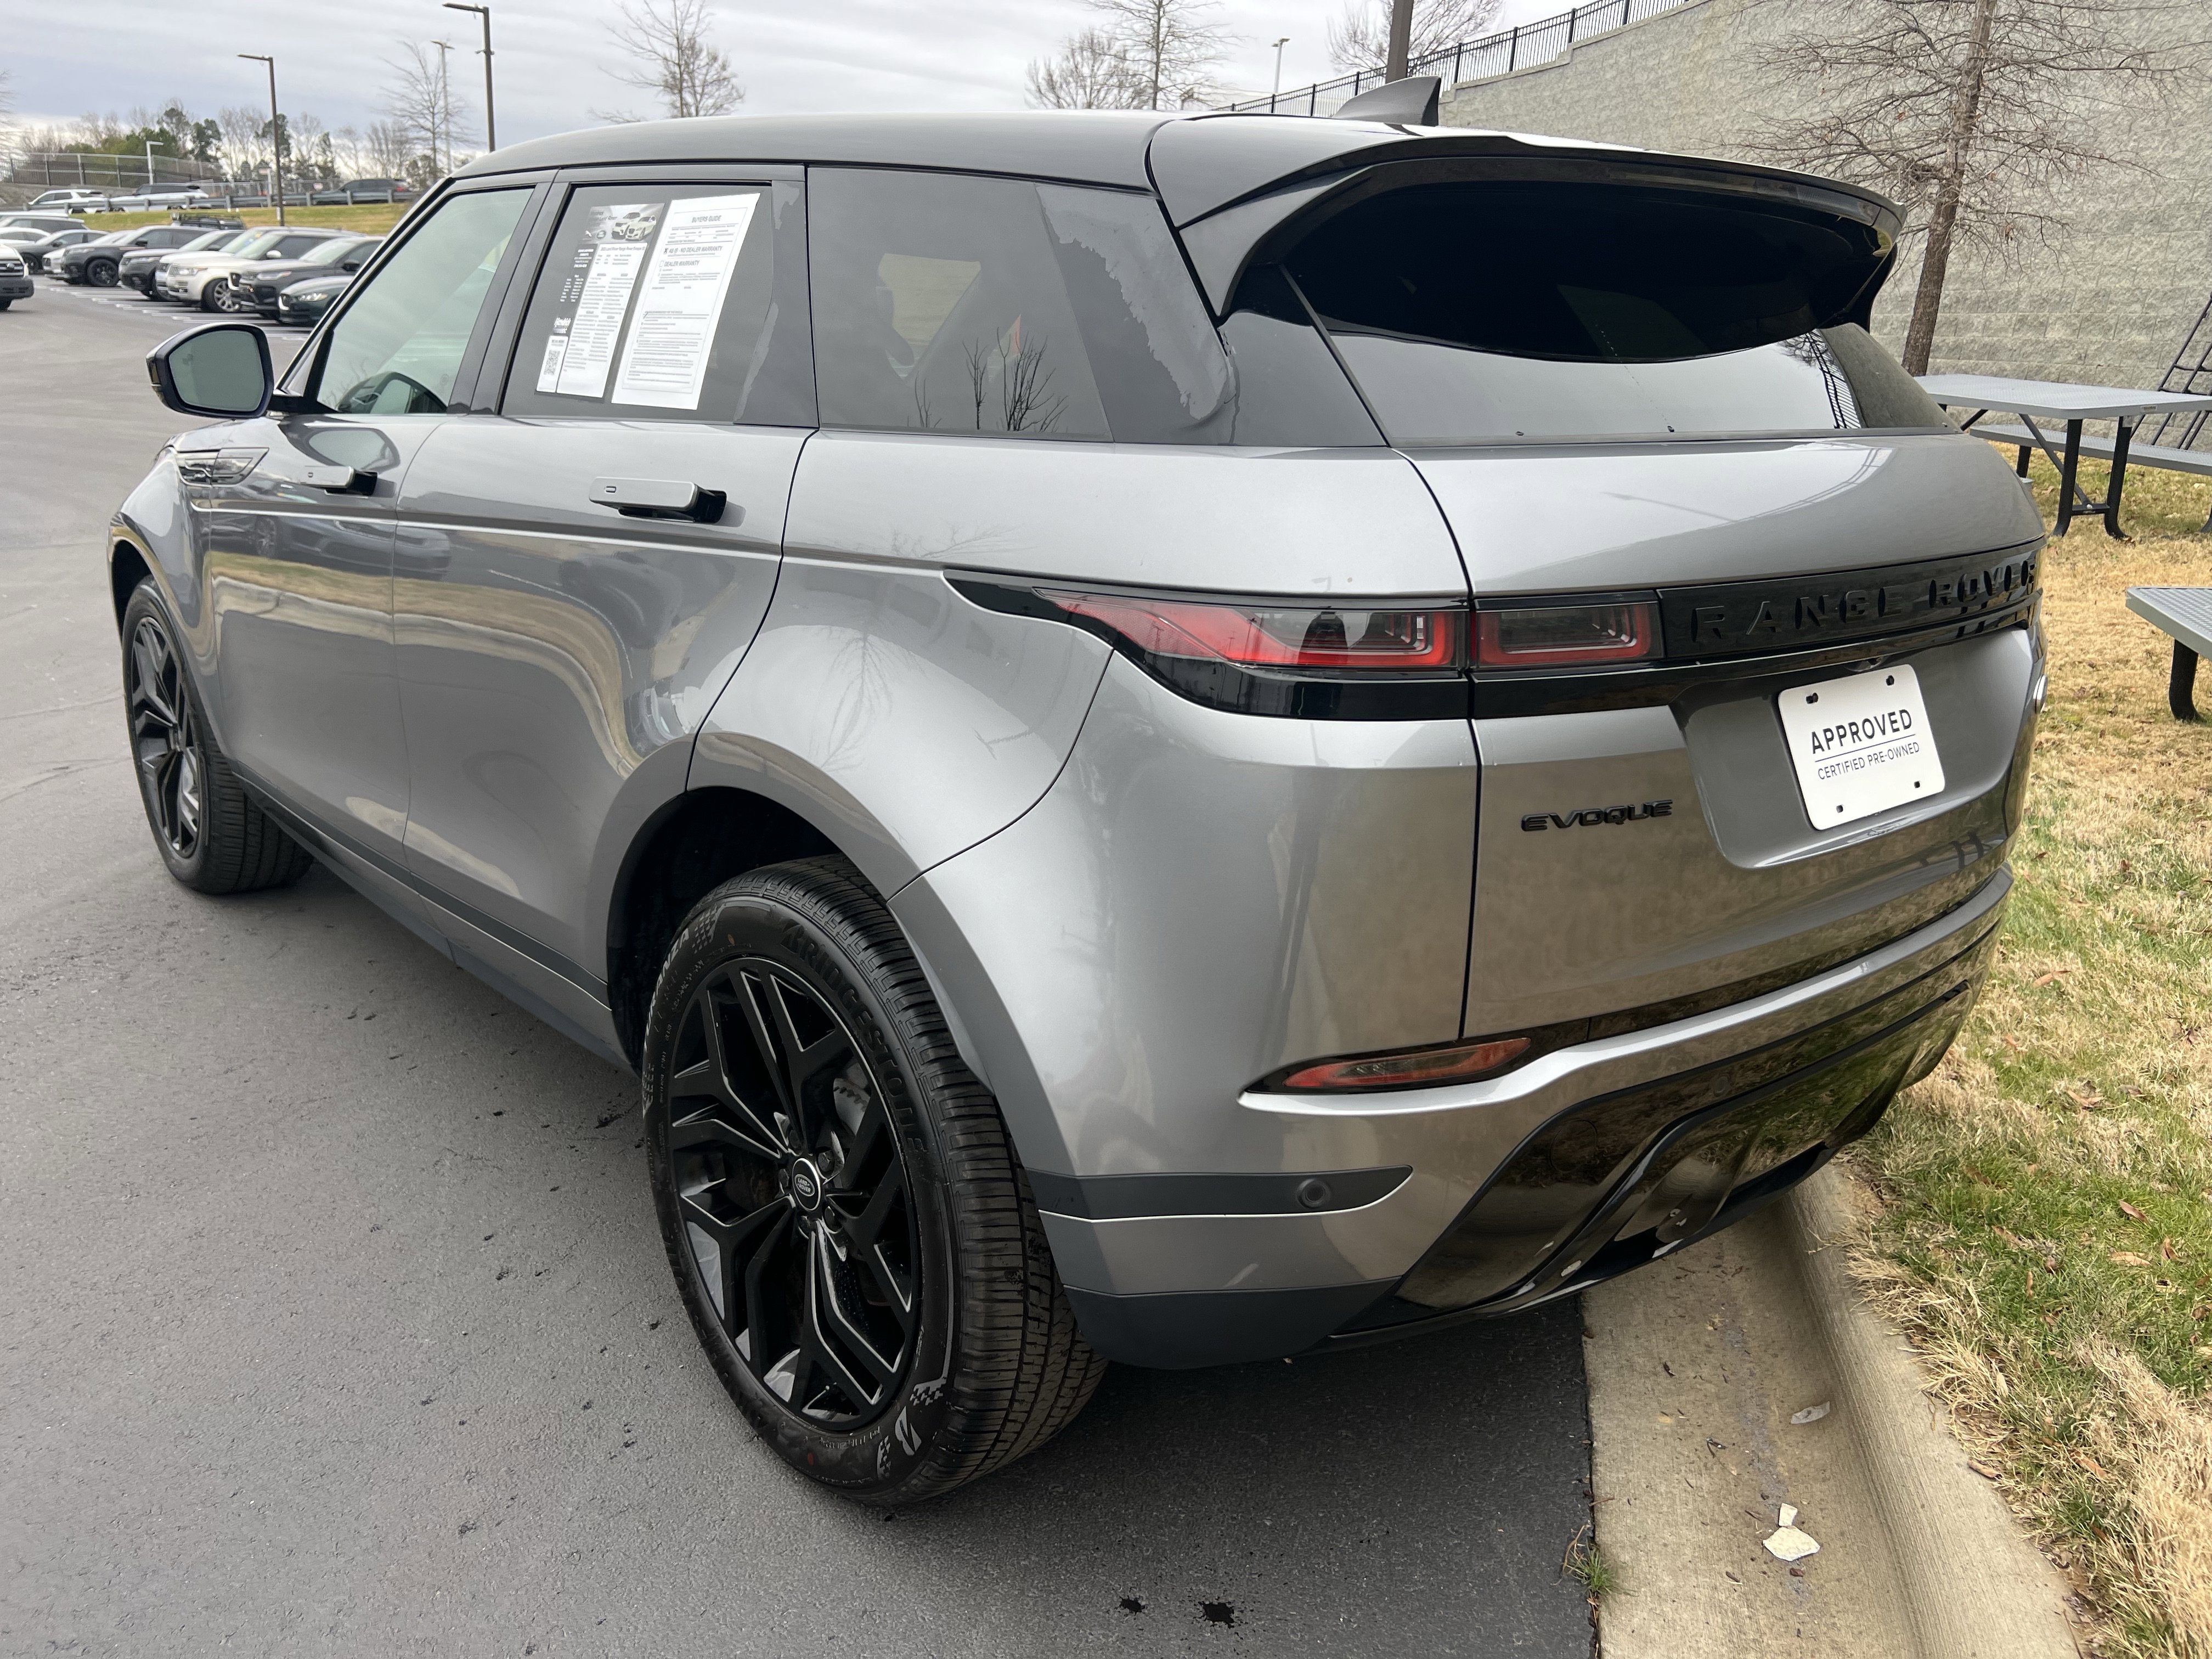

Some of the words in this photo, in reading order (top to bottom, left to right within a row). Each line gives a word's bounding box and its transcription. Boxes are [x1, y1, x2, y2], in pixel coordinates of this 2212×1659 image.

[1691, 585, 1903, 642] RANGE
[1929, 560, 2037, 609] ROVER
[1811, 709, 1912, 754] APPROVED
[1818, 757, 1865, 780] CERTIFIED
[1867, 742, 1920, 766] PRE-OWNED
[1521, 799, 1673, 832] EVOQUE
[780, 918, 929, 1154] BRIDGESTONE
